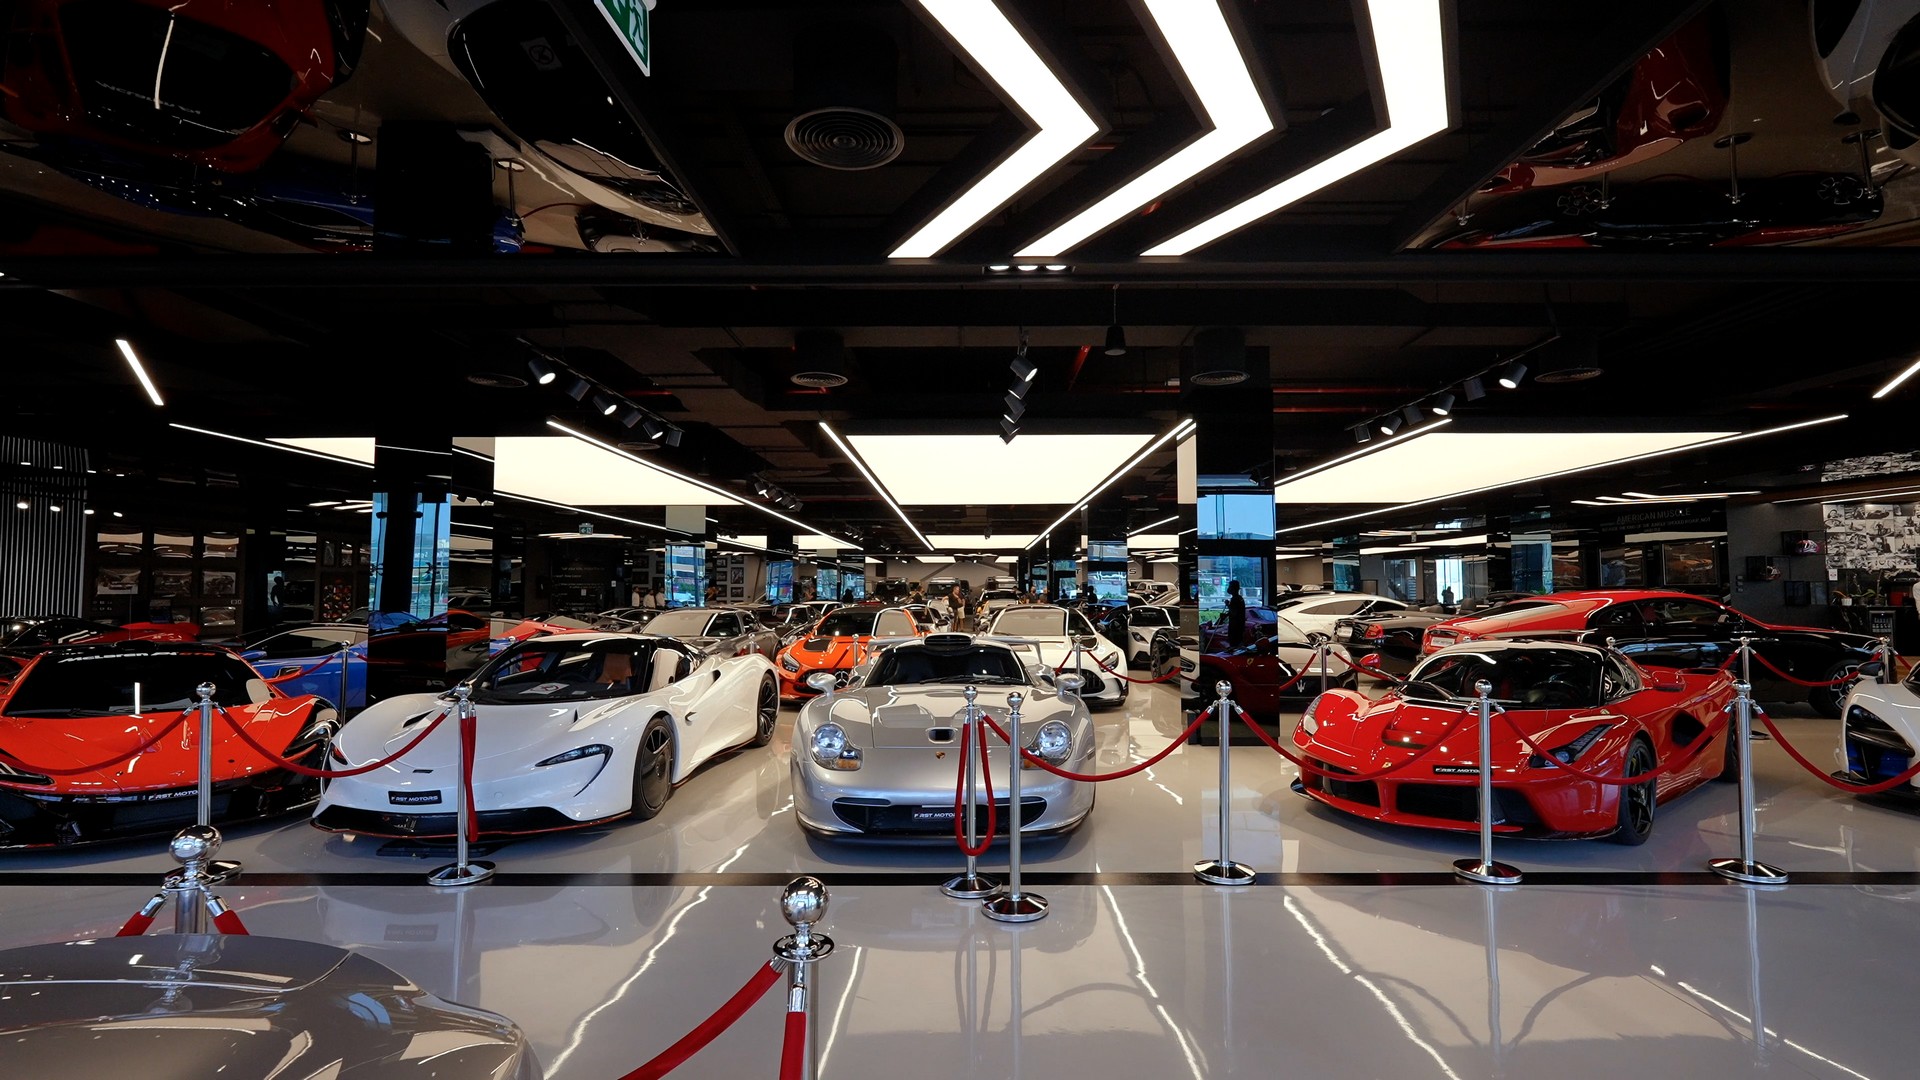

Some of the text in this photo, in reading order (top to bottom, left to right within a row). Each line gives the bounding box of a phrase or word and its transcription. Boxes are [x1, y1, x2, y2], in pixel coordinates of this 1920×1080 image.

[1616, 507, 1691, 522] AMERICAN MUSCLE
[58, 652, 149, 663] McLaren
[148, 793, 173, 801] FRST
